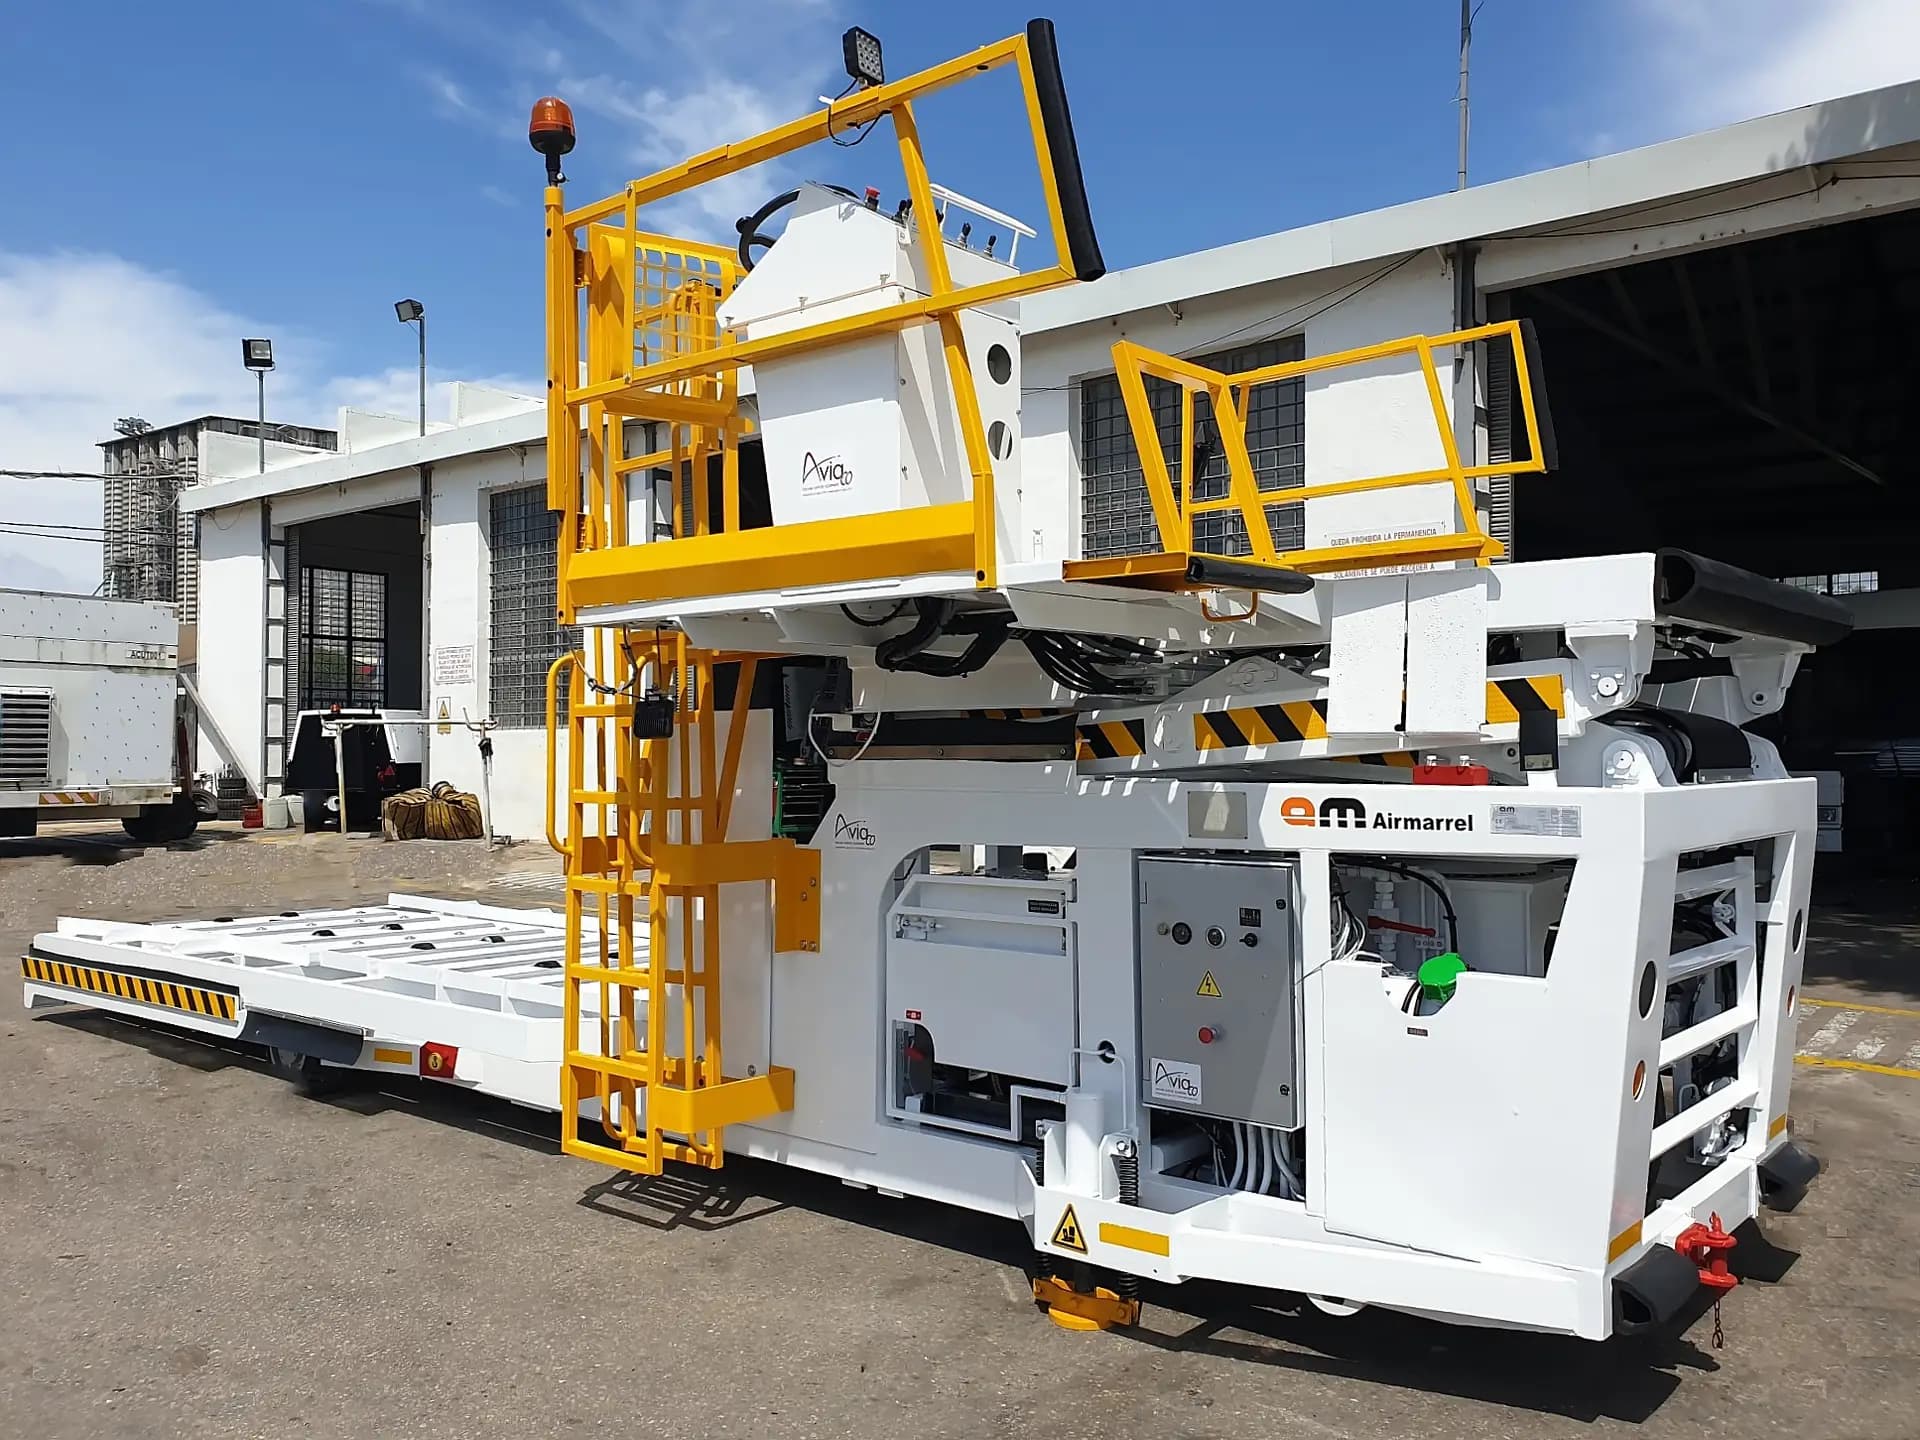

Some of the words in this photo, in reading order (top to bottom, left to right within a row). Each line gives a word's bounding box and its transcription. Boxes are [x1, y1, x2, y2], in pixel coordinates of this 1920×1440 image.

[1330, 538, 1350, 546] QUEDA
[1351, 534, 1382, 543] PROHIBIDA
[1384, 533, 1392, 541] LA
[1393, 528, 1437, 540] PERMANENCIA
[1373, 812, 1474, 832] Airmarrel
